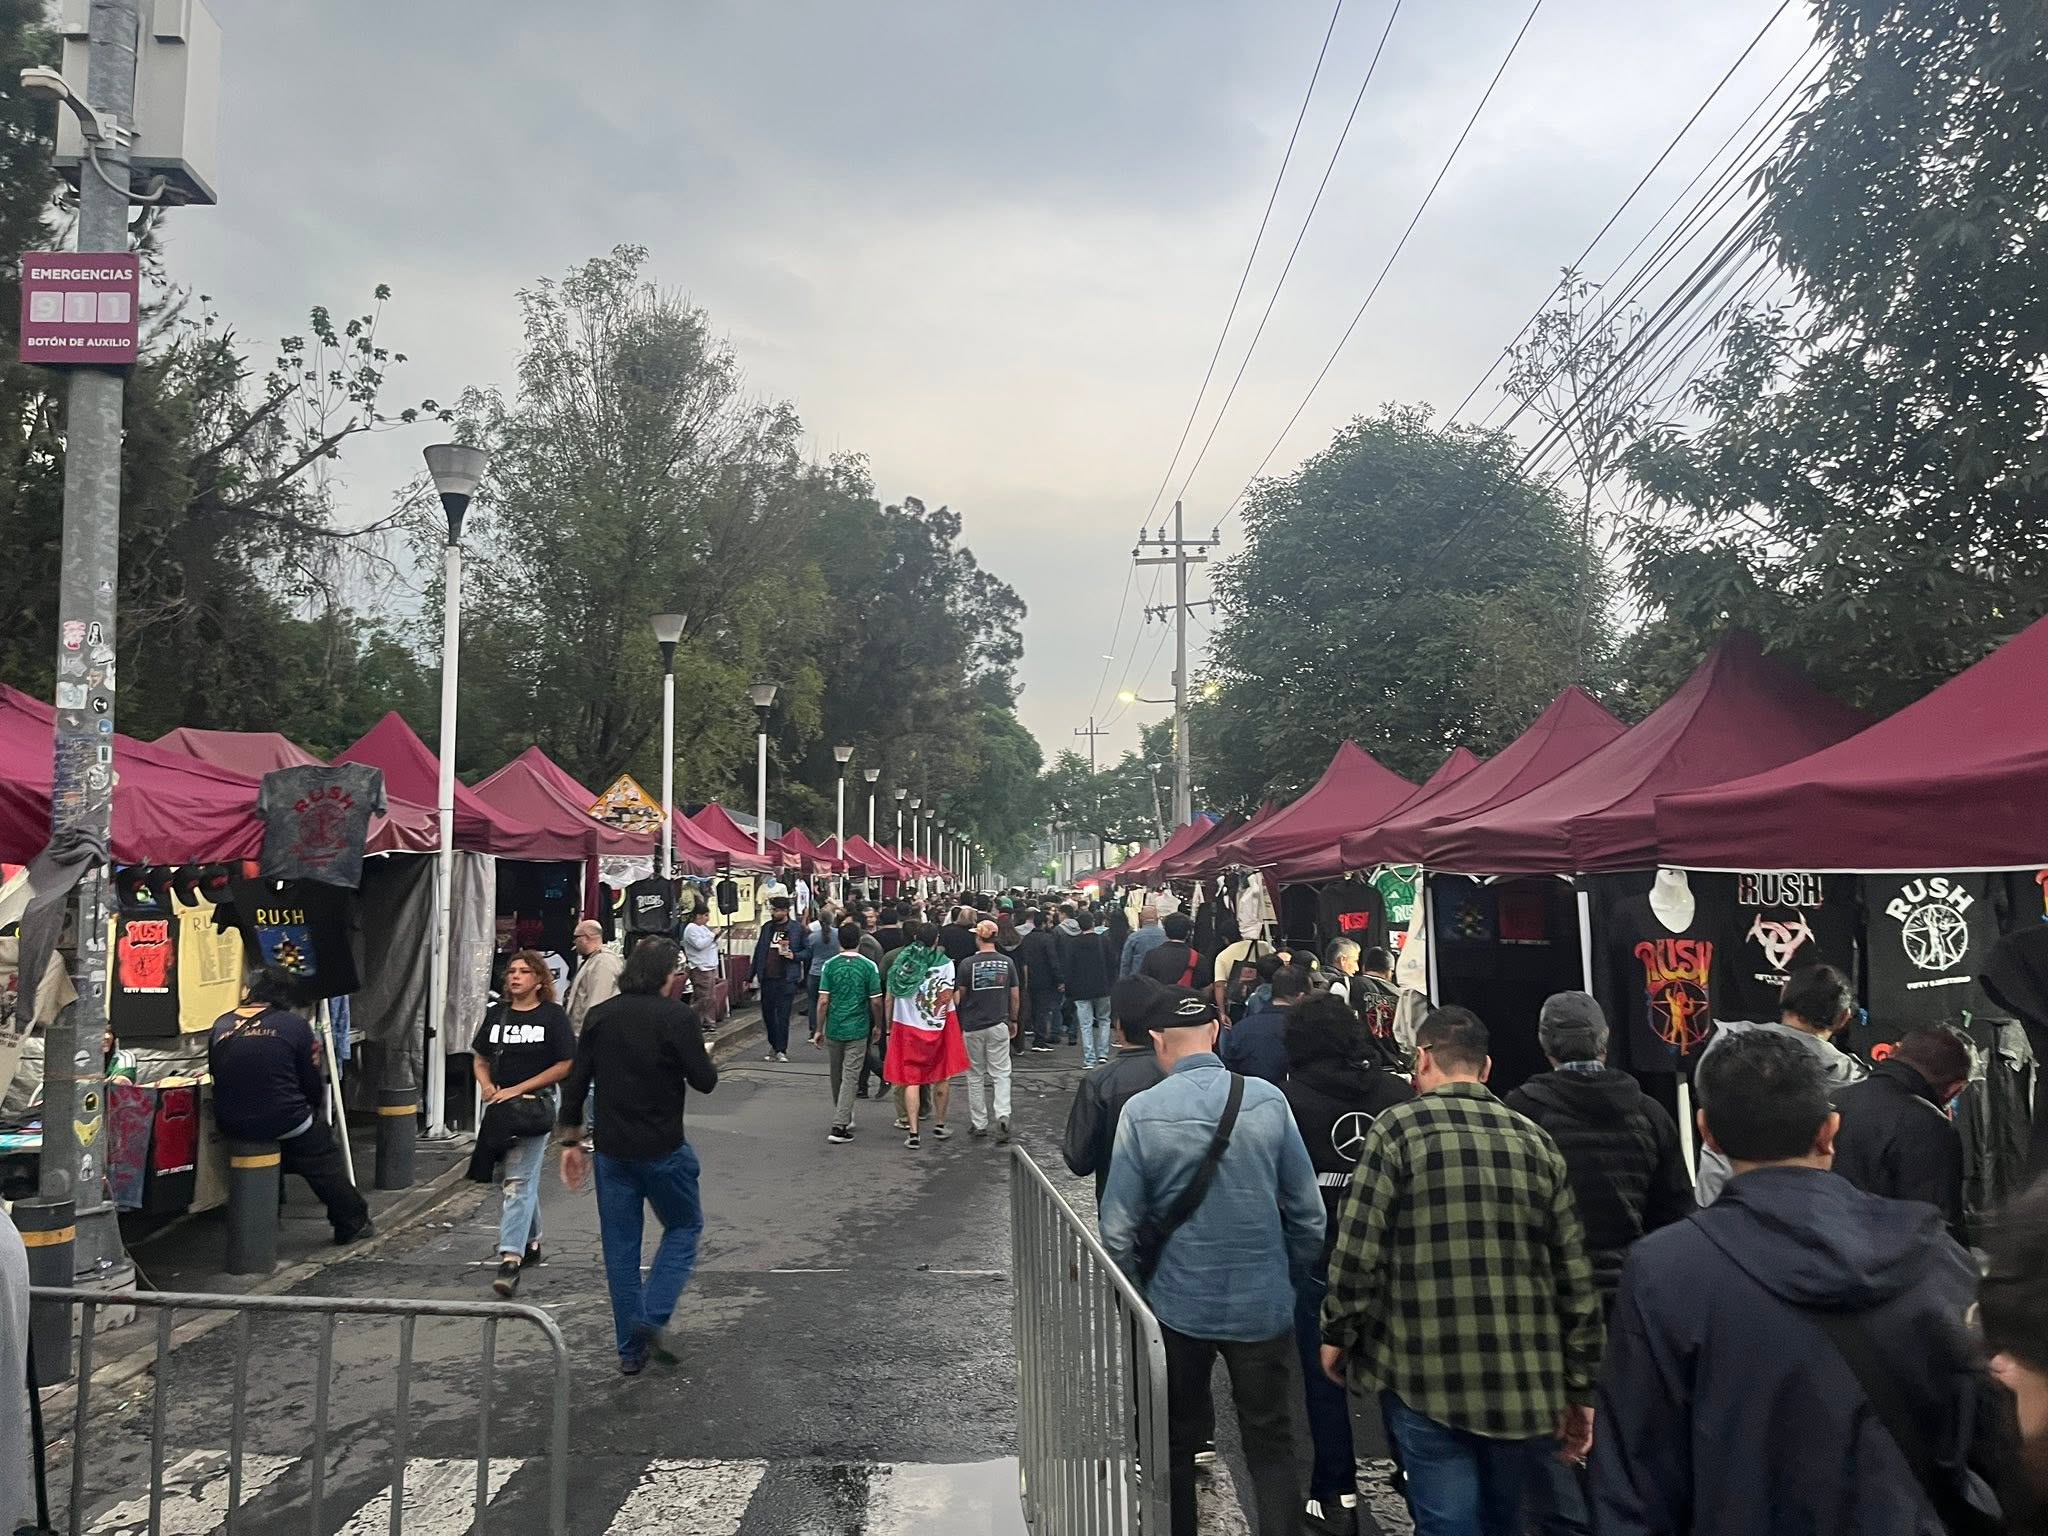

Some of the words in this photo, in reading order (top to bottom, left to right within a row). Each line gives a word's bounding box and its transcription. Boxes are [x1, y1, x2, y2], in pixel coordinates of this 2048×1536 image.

[31, 268, 133, 281] EMERGENCIAS
[33, 296, 121, 320] 911
[28, 336, 67, 347] BOTÓN
[69, 338, 85, 347] DE
[86, 338, 131, 347] AUXILIO
[1738, 872, 1824, 908] RUSH
[1885, 877, 1975, 923] RUSH
[256, 908, 305, 925] RUSH
[127, 921, 168, 942] RUSH
[1634, 938, 1715, 987] RUSH
